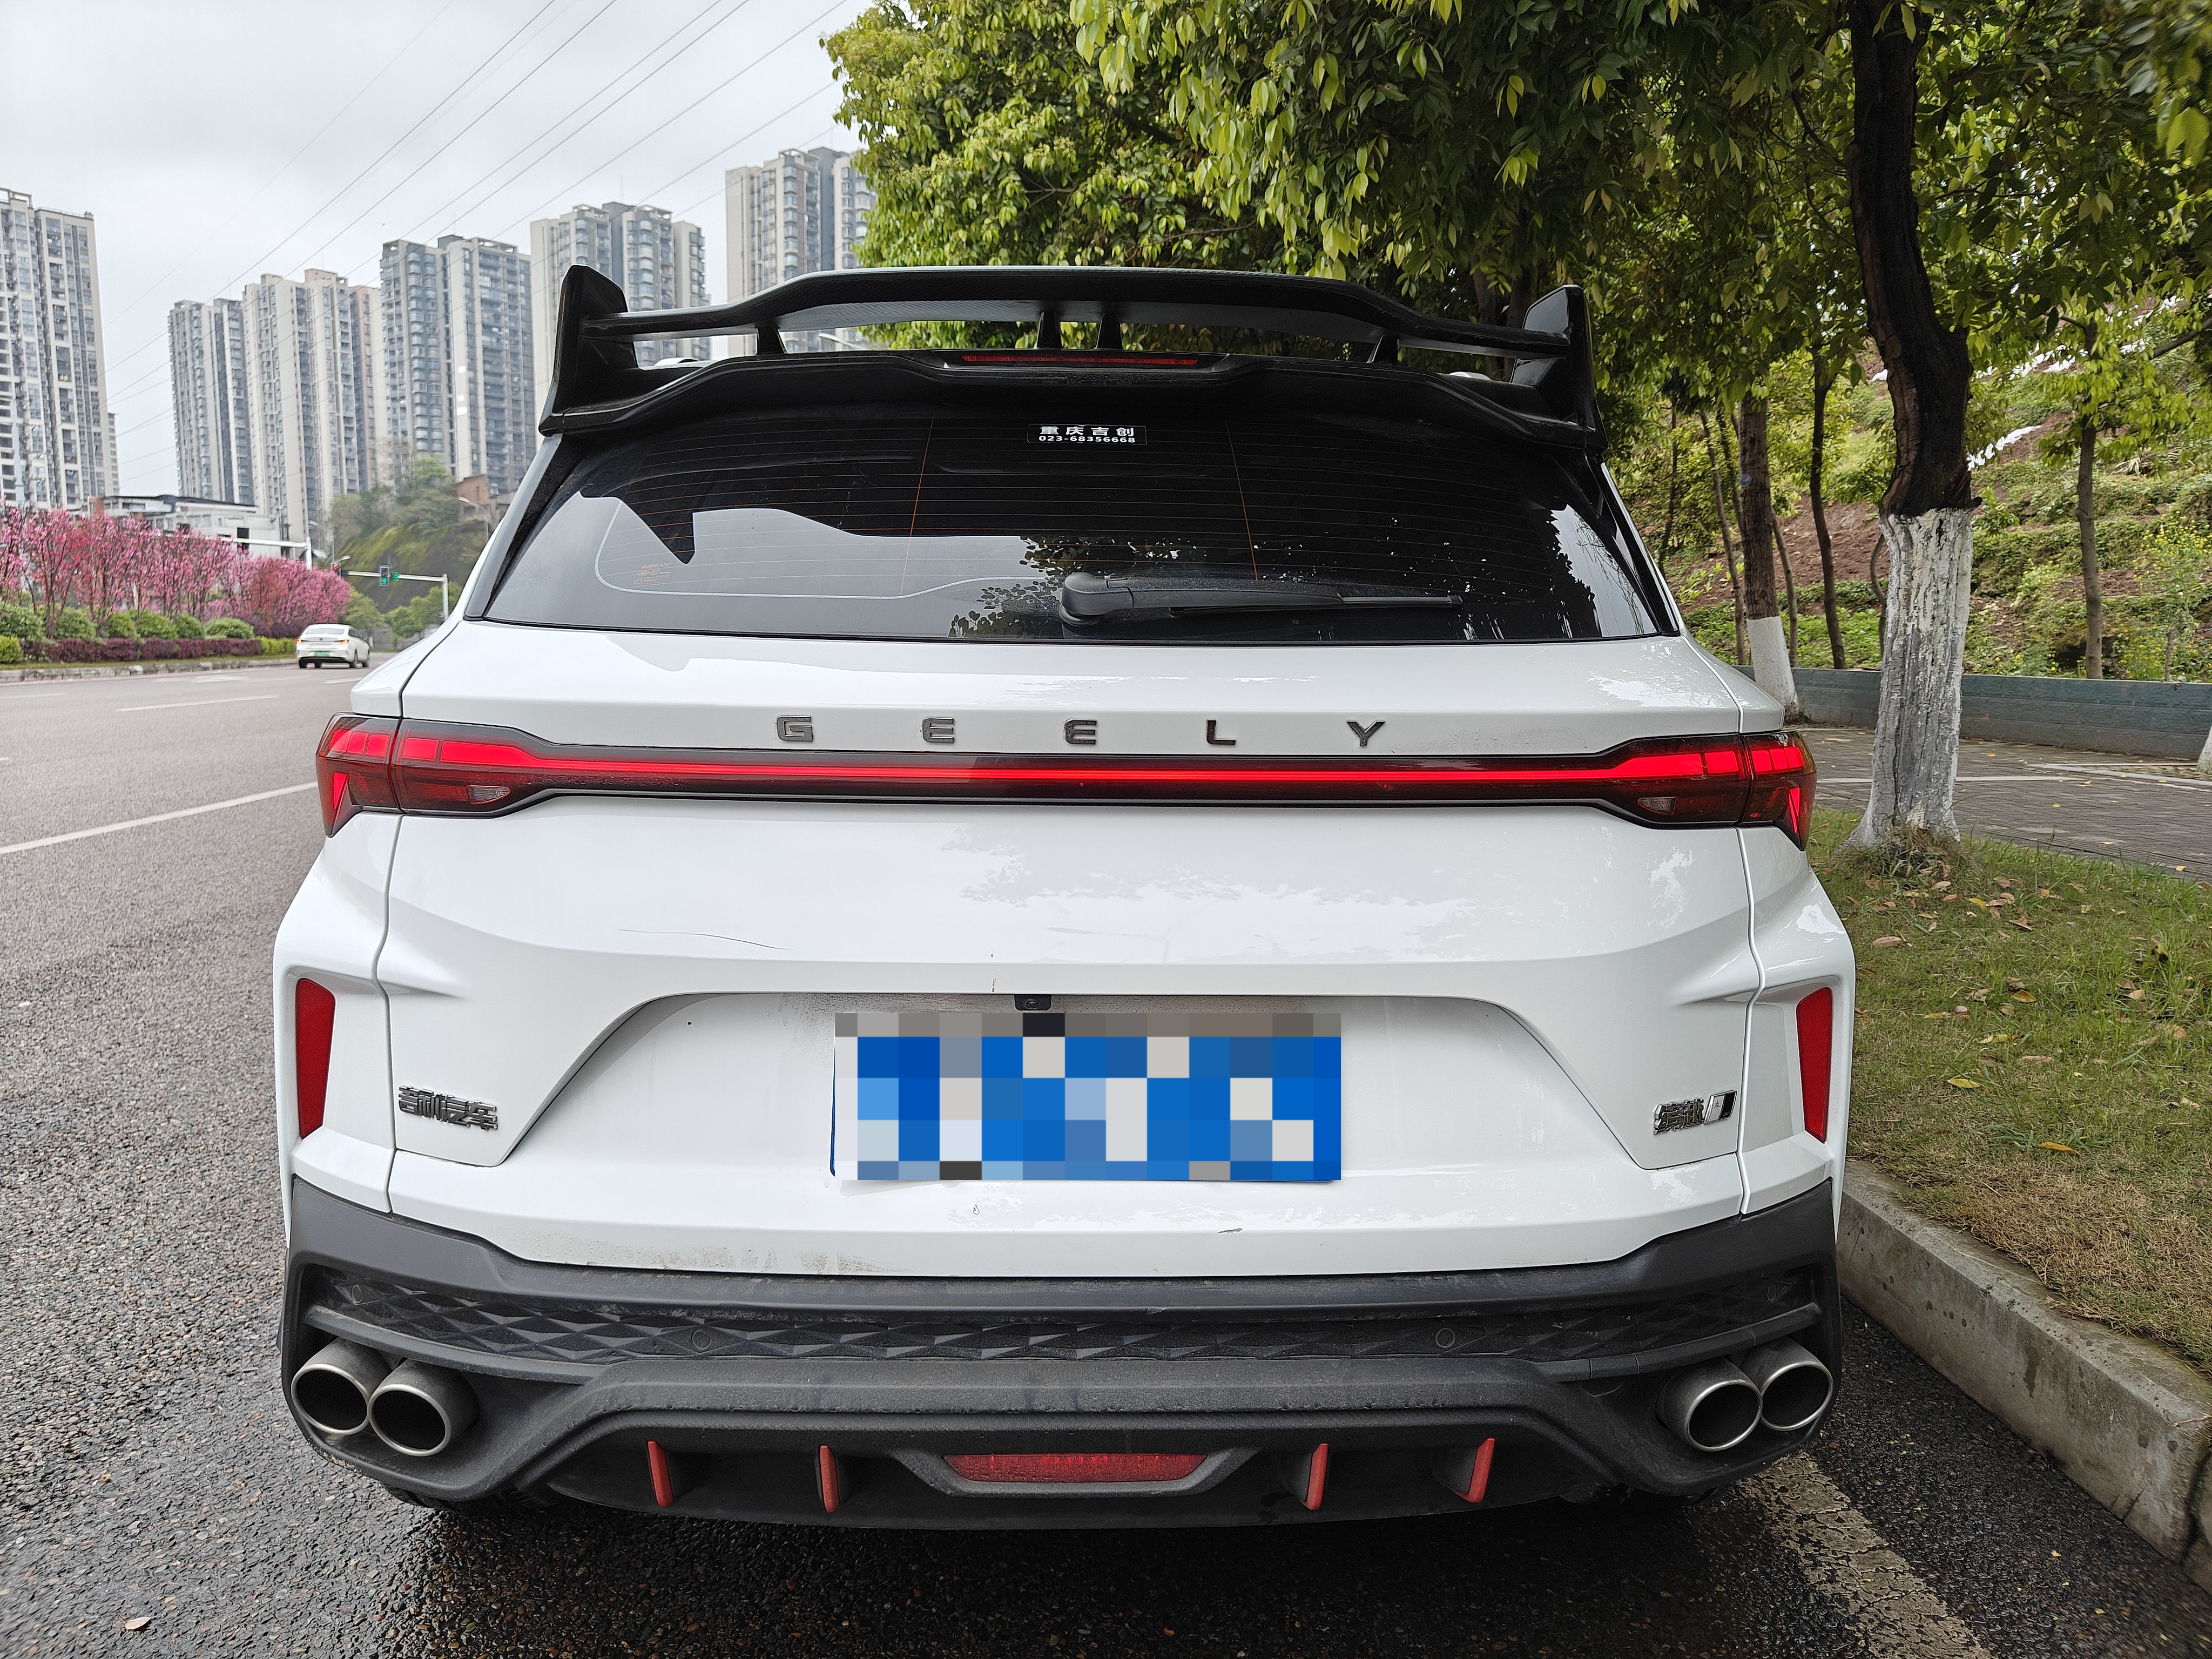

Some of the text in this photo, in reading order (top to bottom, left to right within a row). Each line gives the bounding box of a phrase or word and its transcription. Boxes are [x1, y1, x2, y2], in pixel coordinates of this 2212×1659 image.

[1040, 426, 1135, 437] 重庆吉创
[776, 715, 1386, 746] GEELY
[398, 1085, 498, 1131] 吉利汽车
